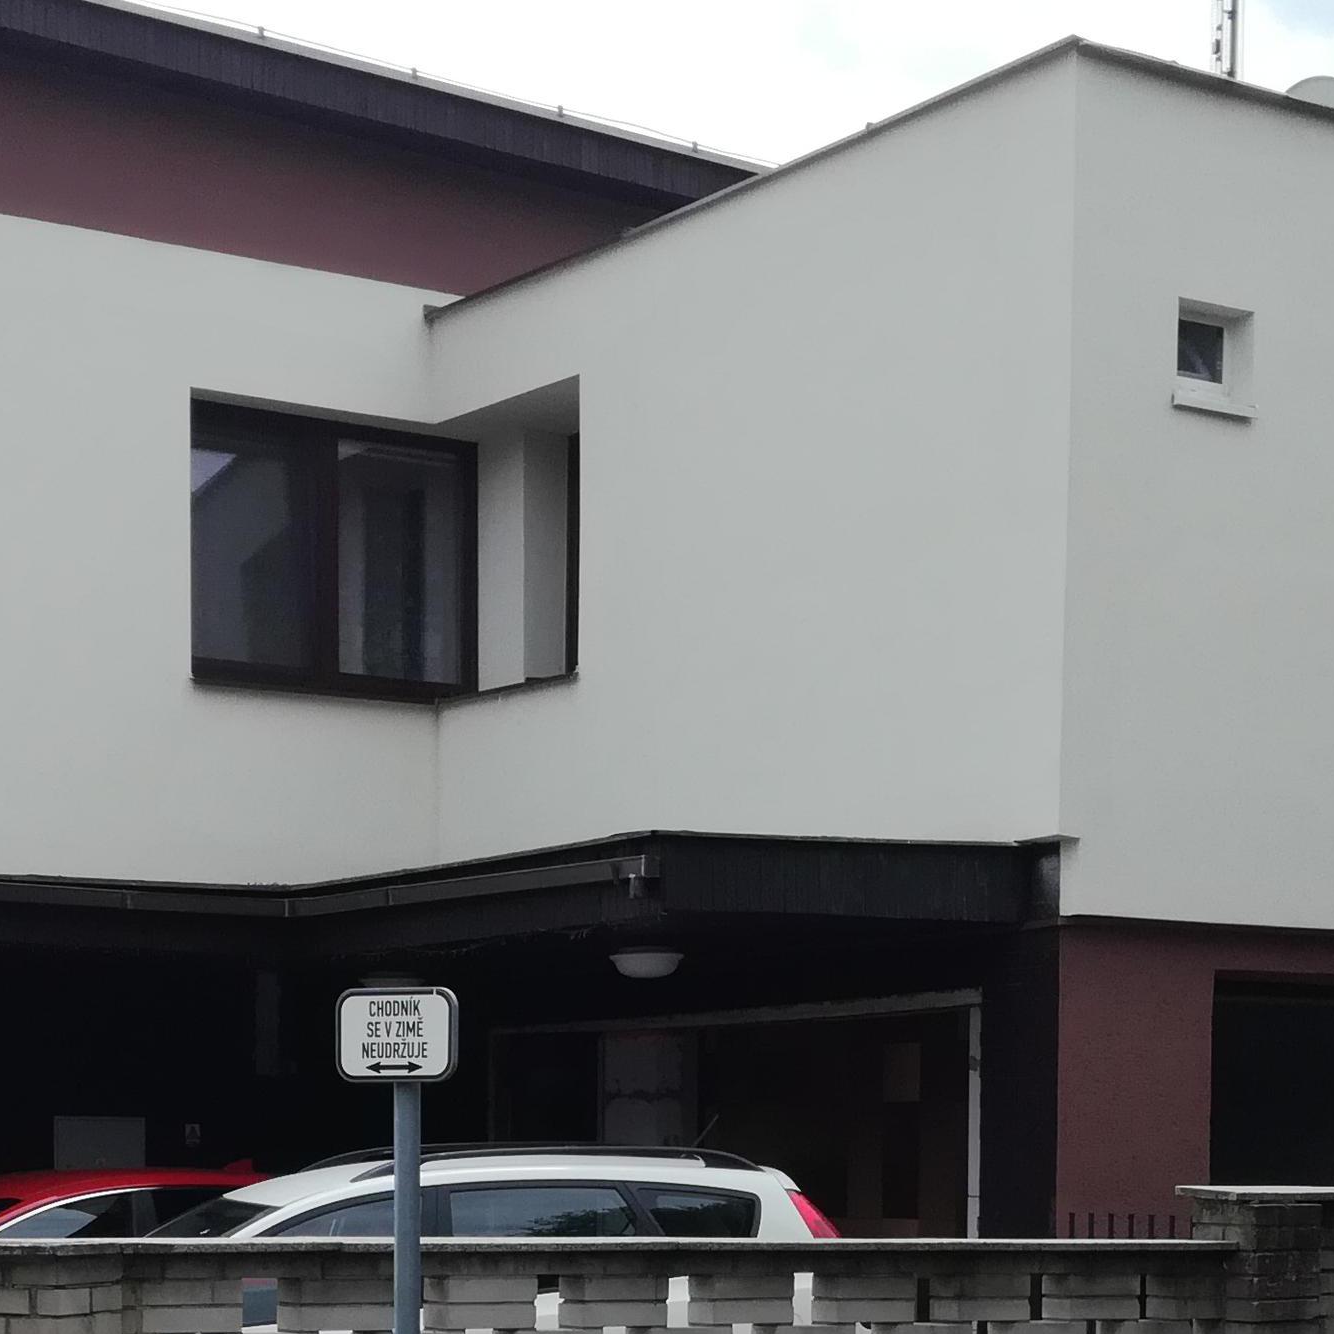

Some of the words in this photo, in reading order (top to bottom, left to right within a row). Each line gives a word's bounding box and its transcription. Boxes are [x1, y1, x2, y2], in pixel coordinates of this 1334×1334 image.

[369, 996, 421, 1017] CHODNÍK
[367, 1021, 381, 1038] SE
[385, 1021, 392, 1038] V
[395, 1017, 424, 1037] ZIMĚ
[362, 1039, 428, 1059] NEUDRŽUJE
